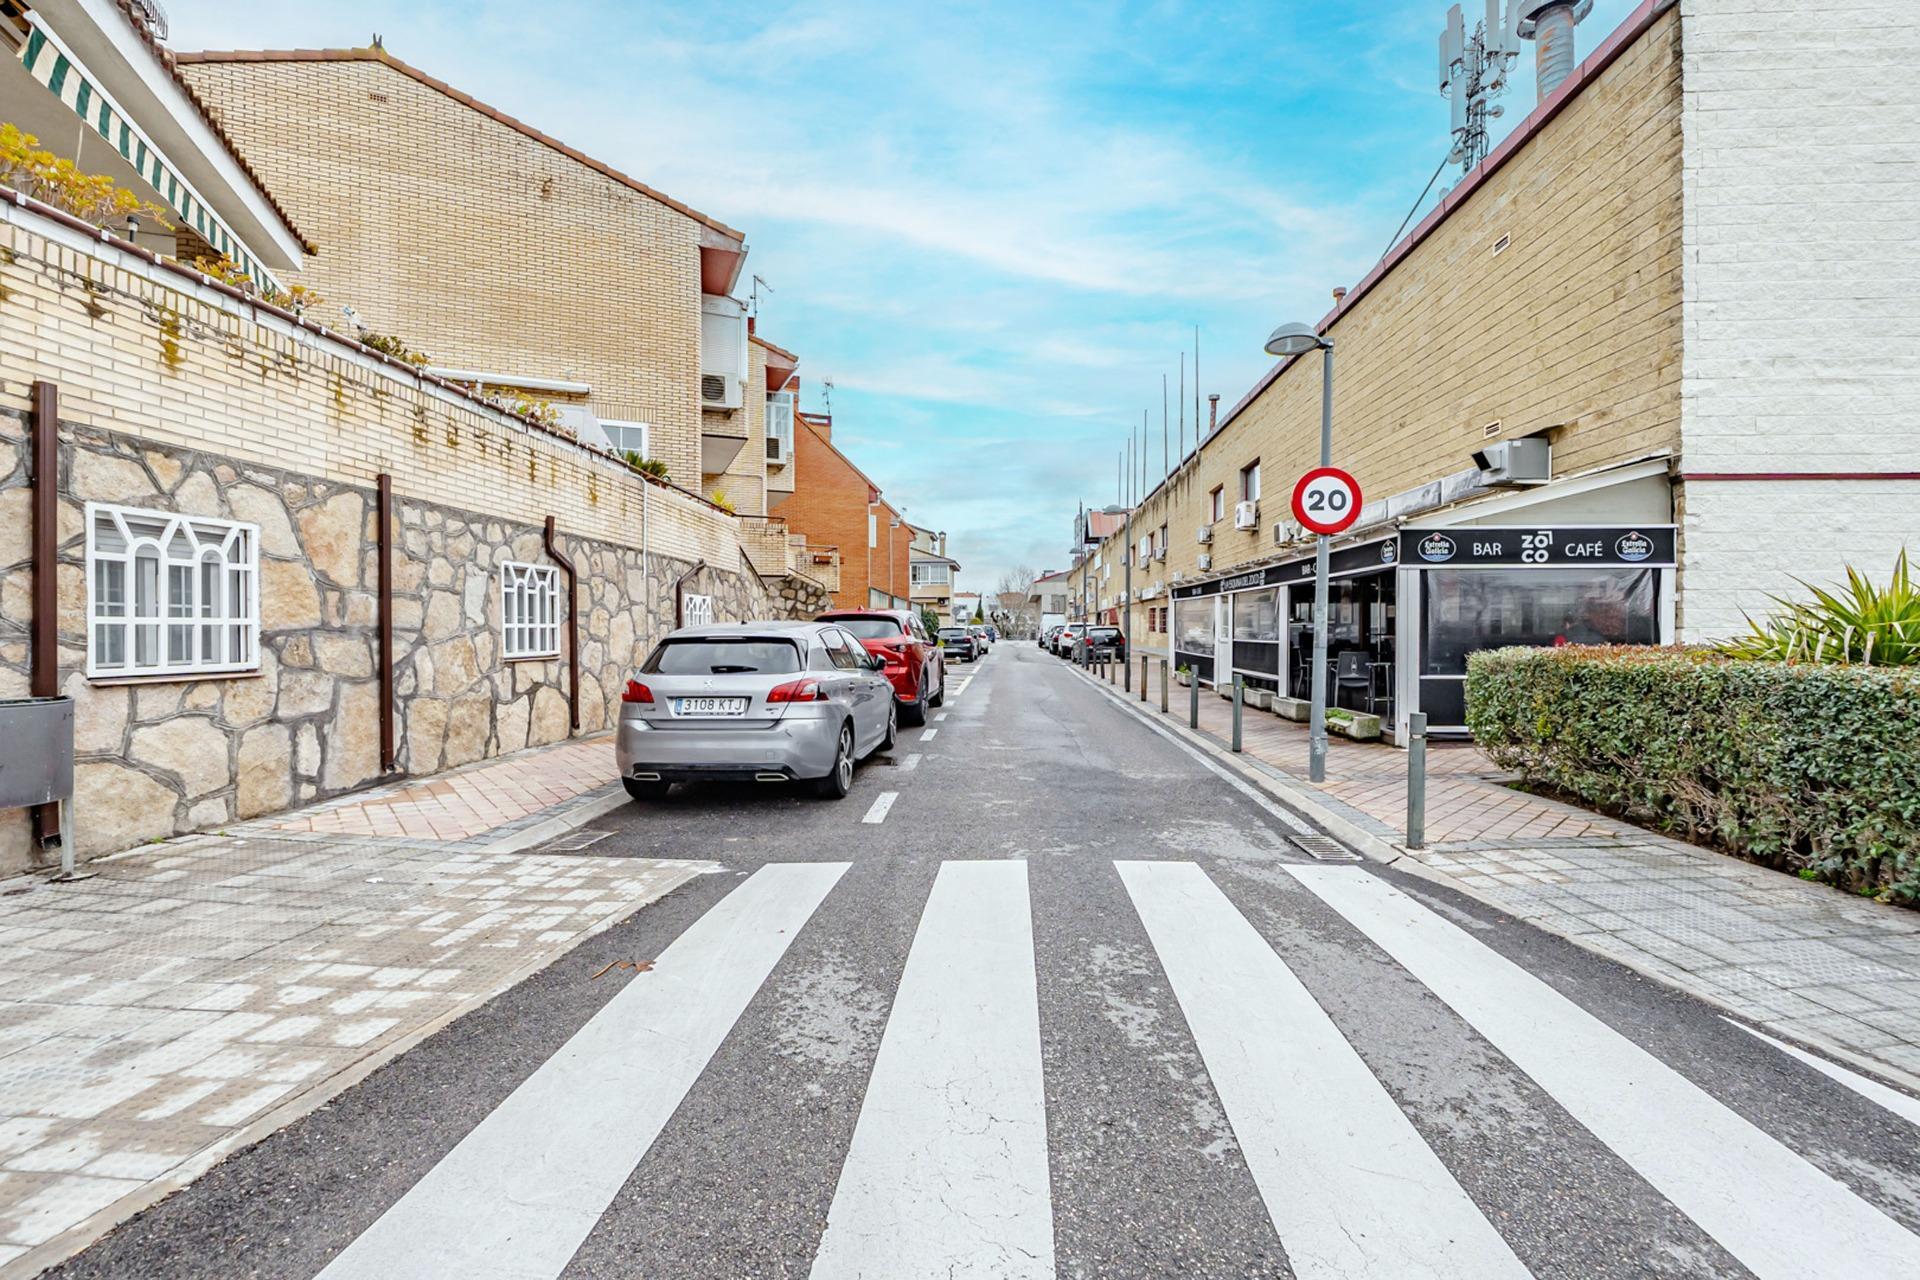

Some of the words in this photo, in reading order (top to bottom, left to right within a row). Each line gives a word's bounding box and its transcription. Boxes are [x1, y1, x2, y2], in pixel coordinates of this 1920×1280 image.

[1308, 489, 1347, 511] 20
[1473, 542, 1502, 556] BAR
[1565, 540, 1603, 557] CAFÉ
[685, 699, 714, 711] 3108
[719, 699, 742, 711] KTJ
